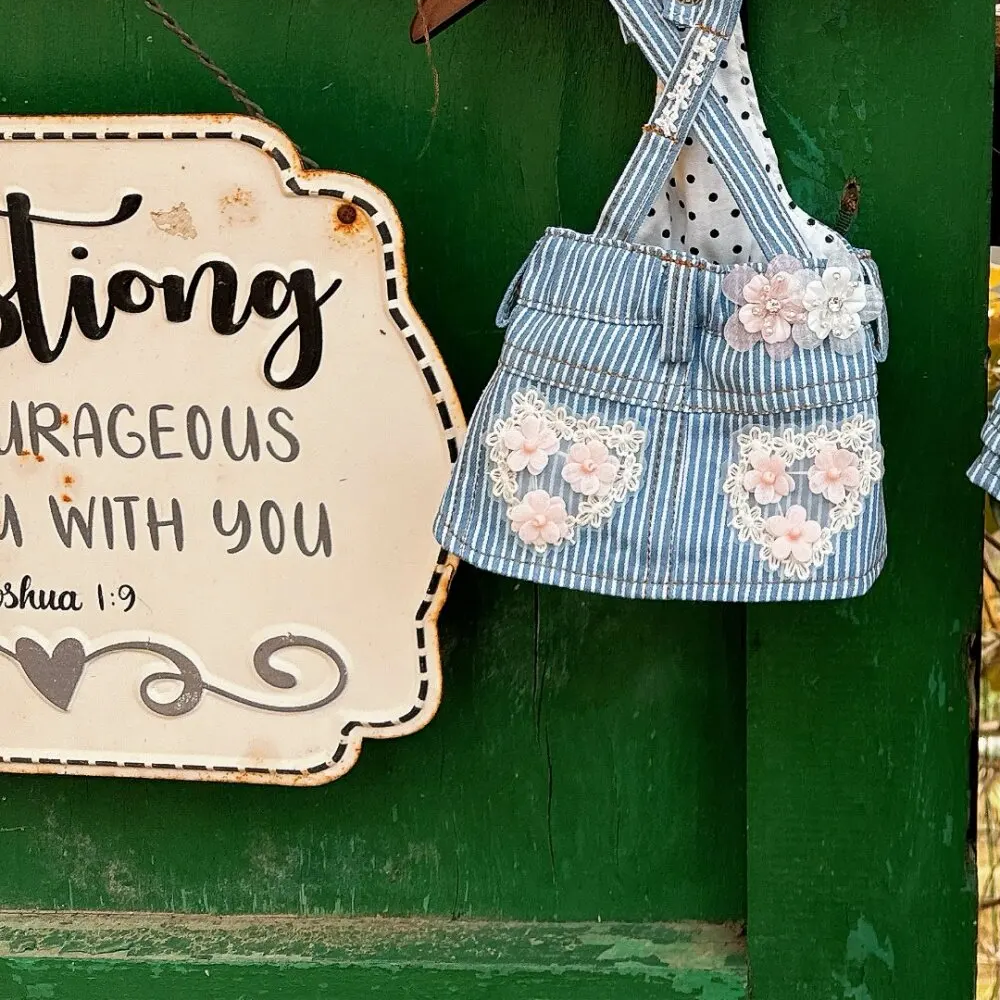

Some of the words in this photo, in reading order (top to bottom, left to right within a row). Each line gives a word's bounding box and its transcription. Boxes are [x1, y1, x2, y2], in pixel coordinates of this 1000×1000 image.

[49, 495, 184, 552] WITH
[0, 574, 83, 611] shua
[97, 583, 136, 613] 1:9
